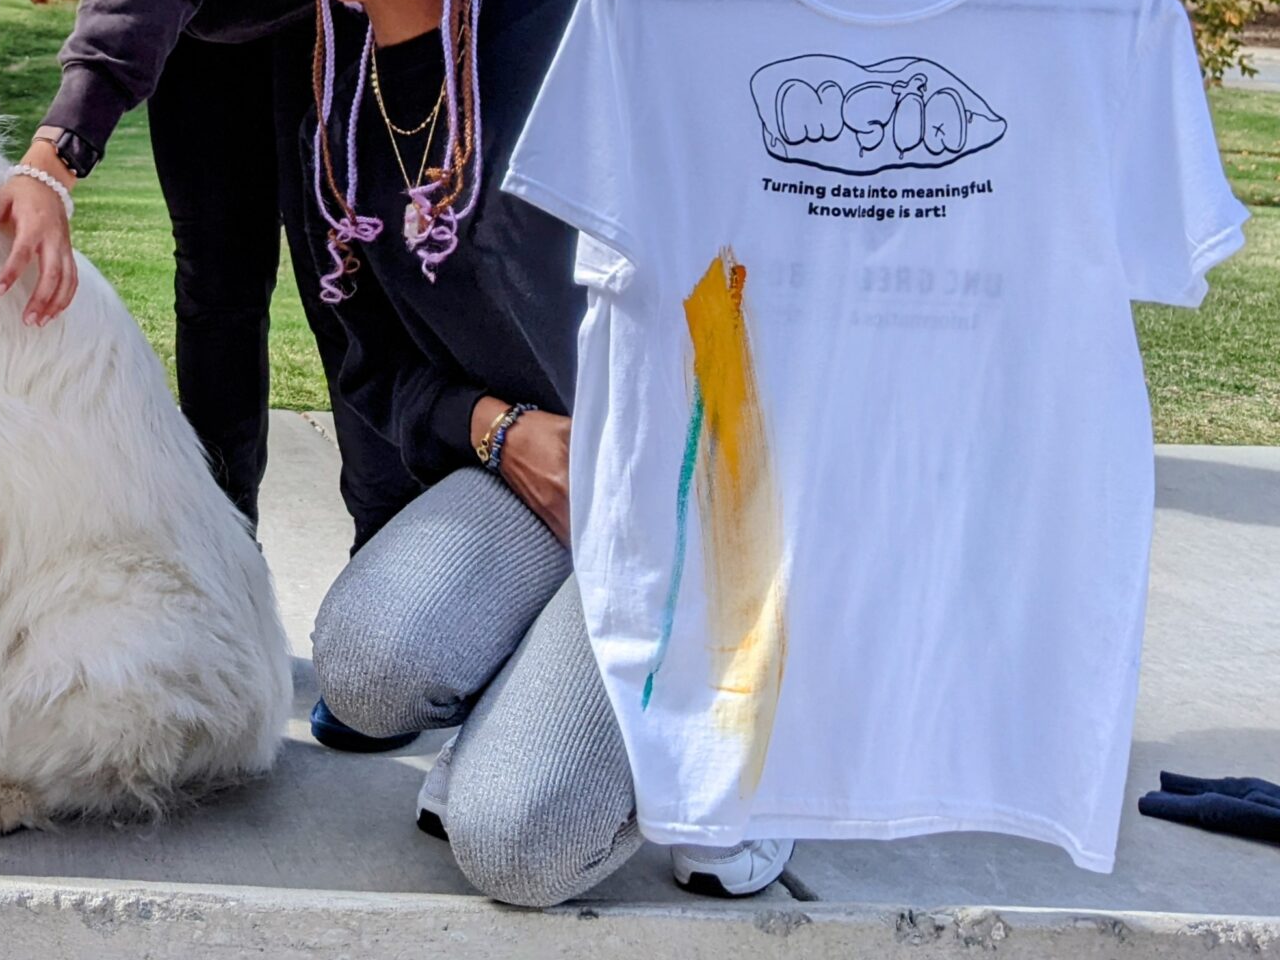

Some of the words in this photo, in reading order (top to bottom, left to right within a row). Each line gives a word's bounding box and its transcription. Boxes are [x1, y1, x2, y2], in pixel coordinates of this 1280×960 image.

[762, 177, 826, 199] Turning
[830, 183, 866, 199] data
[866, 184, 898, 199] into
[901, 179, 993, 199] meaningful
[807, 202, 895, 221] knowledge
[899, 204, 911, 219] is
[914, 204, 947, 218] art!
